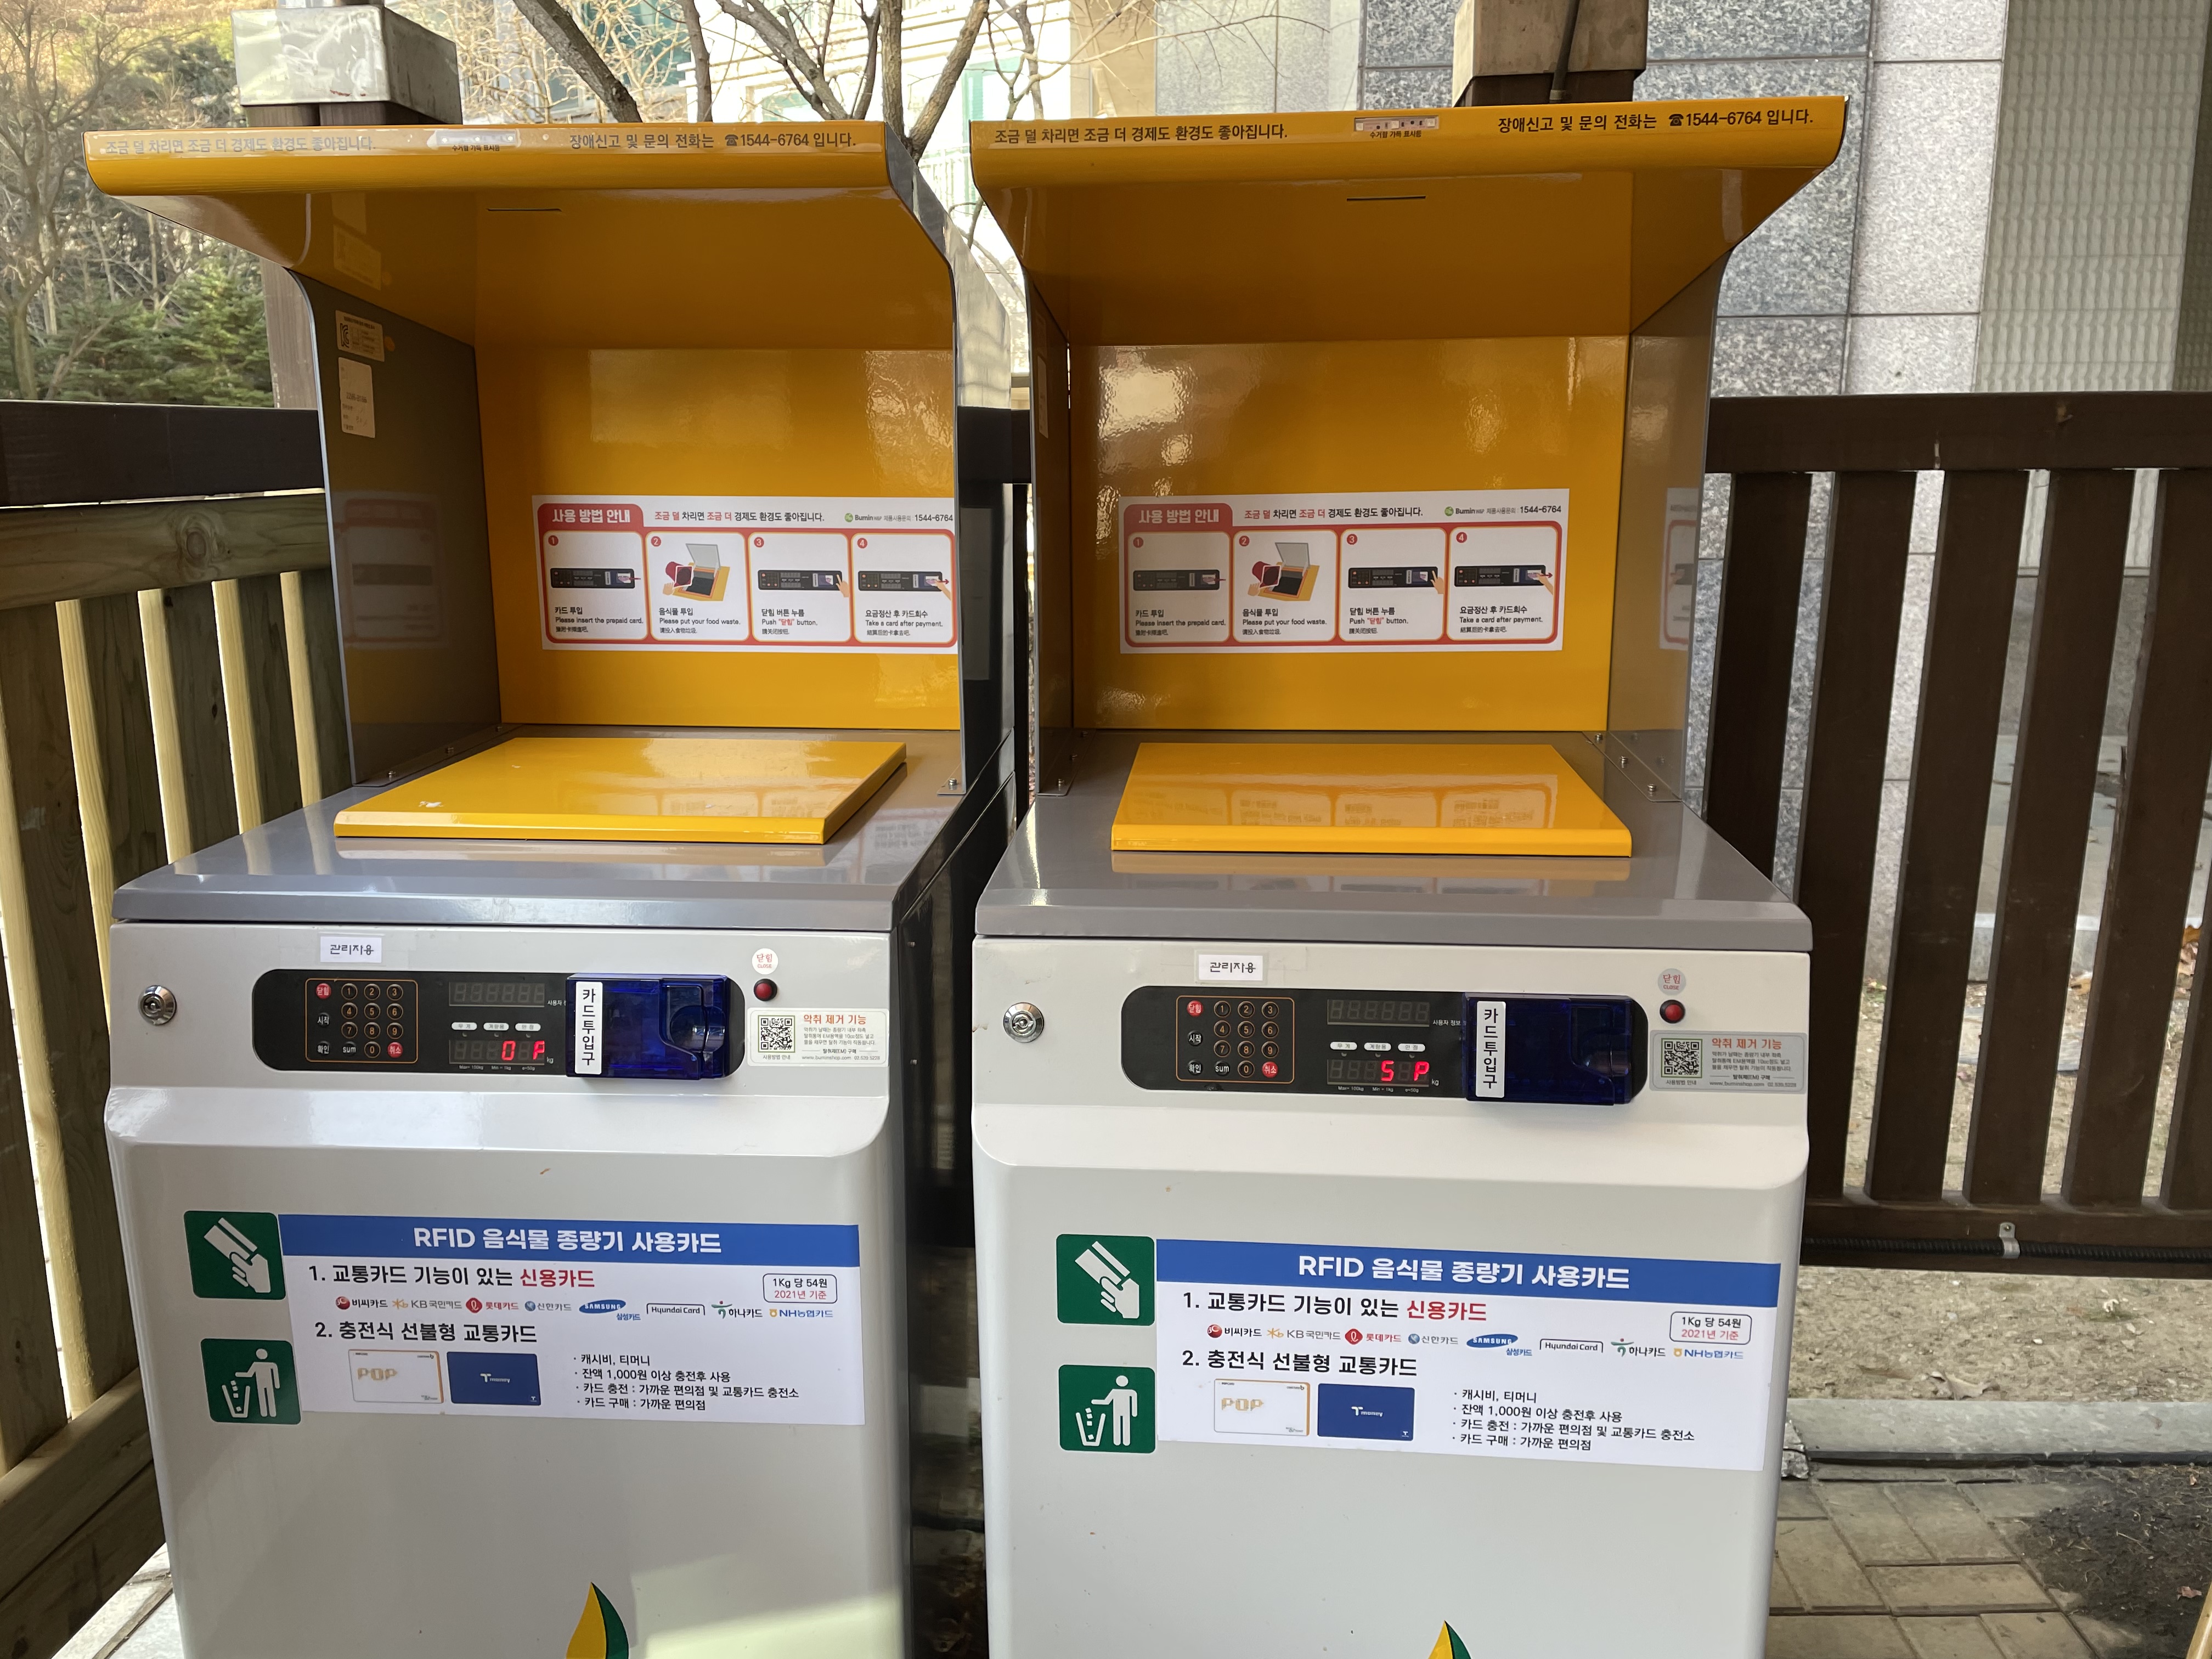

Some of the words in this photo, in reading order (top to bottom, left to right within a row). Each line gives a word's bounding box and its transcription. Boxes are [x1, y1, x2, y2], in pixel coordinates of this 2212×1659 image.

[1498, 117, 1553, 133] 장애신고
[1561, 116, 1572, 131] 및
[1579, 115, 1606, 130] 문의
[1615, 114, 1657, 129] 전화는
[1686, 112, 1762, 127] 1544-6764
[1767, 109, 1813, 125] 입니다.
[570, 134, 620, 149] 장애신고
[627, 134, 638, 149] 및
[644, 133, 668, 148] 문의
[675, 133, 714, 148] 전화는
[741, 133, 809, 146] 1544-6764
[814, 132, 856, 148] 입니다.
[995, 130, 1019, 144] 조금
[1025, 129, 1036, 143] 덜
[1042, 128, 1079, 143] 차리면
[1084, 128, 1109, 142] 조금
[1115, 127, 1126, 142] 더
[1132, 127, 1170, 142] 경제도
[1176, 126, 1213, 140] 환경도
[1218, 124, 1287, 140] 좋아집니다.
[106, 142, 128, 154] 조금
[134, 140, 144, 154] 덜
[149, 139, 183, 153] 차리면
[189, 139, 211, 153] 조금
[216, 138, 227, 152] 더
[232, 138, 267, 153] 경제도
[273, 137, 307, 152] 환경도
[313, 136, 376, 151] 좋아집니다.
[552, 510, 575, 522] 사용
[579, 510, 603, 523] 방법
[607, 510, 630, 523] 안내
[1139, 510, 1163, 523] 사용
[1167, 510, 1190, 523] 방법
[1195, 509, 1218, 523] 안내
[1245, 511, 1260, 519] 조금
[1263, 510, 1269, 518] 덜
[1273, 510, 1296, 518] 차리면
[1299, 510, 1314, 518] 조금
[1318, 509, 1324, 518] 더
[1328, 509, 1352, 518] 경제도
[1355, 508, 1378, 517] 환경도
[1381, 507, 1423, 517] 좋아집니다.
[330, 945, 374, 955] 관리자용
[757, 953, 772, 963] 닫힘
[1210, 962, 1256, 973] 관리자용
[1663, 974, 1680, 984] 닫힘
[317, 986, 329, 996] 닫힘
[318, 1016, 329, 1025] 시작
[804, 1014, 822, 1024] 악취
[826, 1015, 844, 1024] 제거
[848, 1015, 866, 1025] 기능
[582, 989, 595, 1065] 카드투입구
[318, 1045, 329, 1054] 확인
[389, 1045, 401, 1054] 취소
[1483, 1008, 1498, 1089] 카드투입구
[1712, 1038, 1732, 1048] 악취
[1736, 1039, 1757, 1049] 제거
[1762, 1039, 1782, 1050] 기능
[414, 1228, 475, 1247] RFID
[483, 1229, 549, 1249] 음식물
[557, 1231, 623, 1251] 종량기
[632, 1232, 721, 1252] 사용카드
[309, 1266, 325, 1280] 1.
[333, 1265, 407, 1283] 교통카드
[414, 1267, 468, 1285] 기능이
[477, 1268, 512, 1286] 있는
[521, 1269, 594, 1287] 신용카드
[1300, 1256, 1363, 1277] RFID
[1372, 1259, 1443, 1281] 음식물
[1452, 1262, 1522, 1284] 종량기
[1532, 1266, 1629, 1288] 사용카드
[774, 1279, 791, 1288] 1Kg
[794, 1278, 803, 1288] 당
[807, 1279, 827, 1288] 54원
[774, 1290, 805, 1300] 2021년
[810, 1291, 826, 1299] 기준
[352, 1299, 388, 1308] 비씨카드
[1184, 1293, 1199, 1308] 1.
[1208, 1293, 1285, 1312] 교통카드
[1295, 1296, 1351, 1315] 기능이
[1361, 1299, 1398, 1317] 있는
[1407, 1301, 1486, 1321] 신용카드
[729, 1309, 762, 1318] 하나카드
[315, 1322, 332, 1337] 2.
[340, 1321, 393, 1340] 충전식
[402, 1323, 455, 1341] 선불형
[464, 1325, 537, 1342] 교통카드
[582, 1354, 615, 1365] 캐시비,
[620, 1355, 650, 1366] 티머니
[1183, 1351, 1199, 1365] 2.
[1208, 1350, 1263, 1370] 충전식
[1273, 1353, 1329, 1372] 선불형
[1339, 1356, 1417, 1376] 교통카드
[583, 1369, 602, 1379] 잔액
[607, 1370, 647, 1380] 1,000원
[651, 1370, 671, 1381] 이상
[675, 1371, 706, 1381] 충전후
[710, 1372, 730, 1383] 사용
[584, 1383, 604, 1393] 카드
[608, 1384, 628, 1394] 충전
[640, 1385, 670, 1395] 가까운
[674, 1386, 704, 1396] 편의점
[709, 1386, 718, 1396] 및
[723, 1387, 764, 1397] 교통카드
[768, 1387, 799, 1398] 충전소
[585, 1397, 605, 1407] 카드
[609, 1398, 629, 1408] 구매
[641, 1399, 671, 1409] 가까운
[675, 1400, 705, 1410] 편의점
